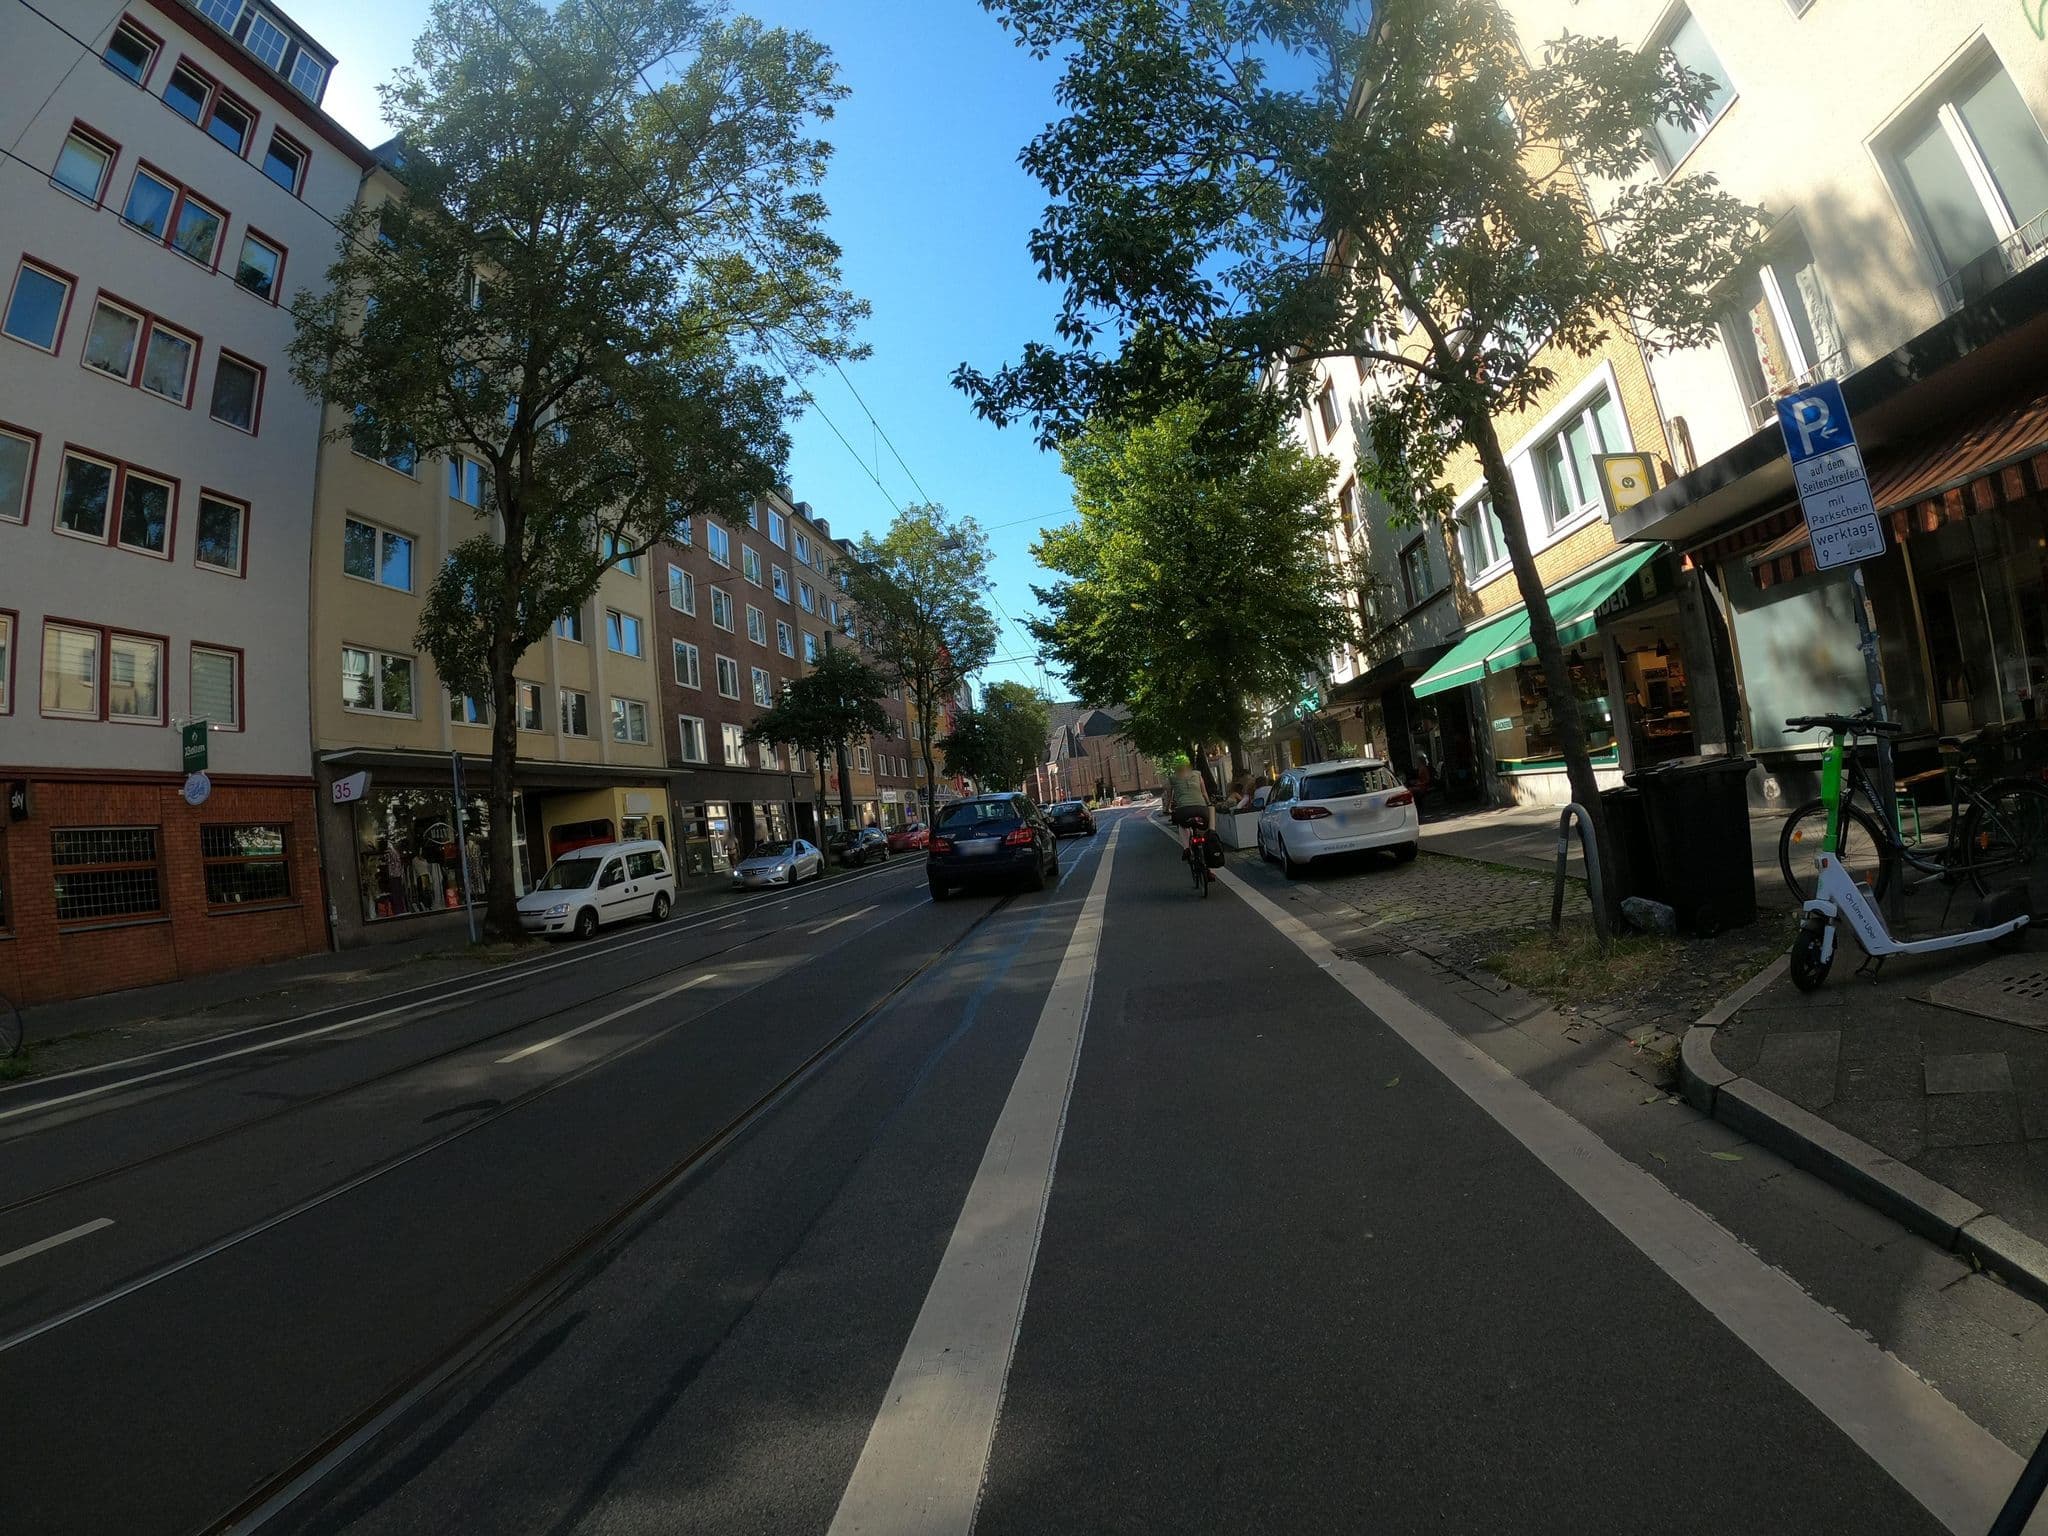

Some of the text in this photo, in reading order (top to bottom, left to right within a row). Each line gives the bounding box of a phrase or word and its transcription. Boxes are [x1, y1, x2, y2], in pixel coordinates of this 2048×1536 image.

[1791, 396, 1830, 456] P
[1809, 457, 1845, 478] auf dem
[1802, 467, 1860, 494] Seitenstreifen
[1828, 494, 1846, 508] mit
[1811, 502, 1869, 526] Parkschein
[1816, 521, 1875, 546] werktags
[1821, 549, 1830, 562] 9
[11, 790, 24, 811] sky
[334, 782, 352, 800] 35
